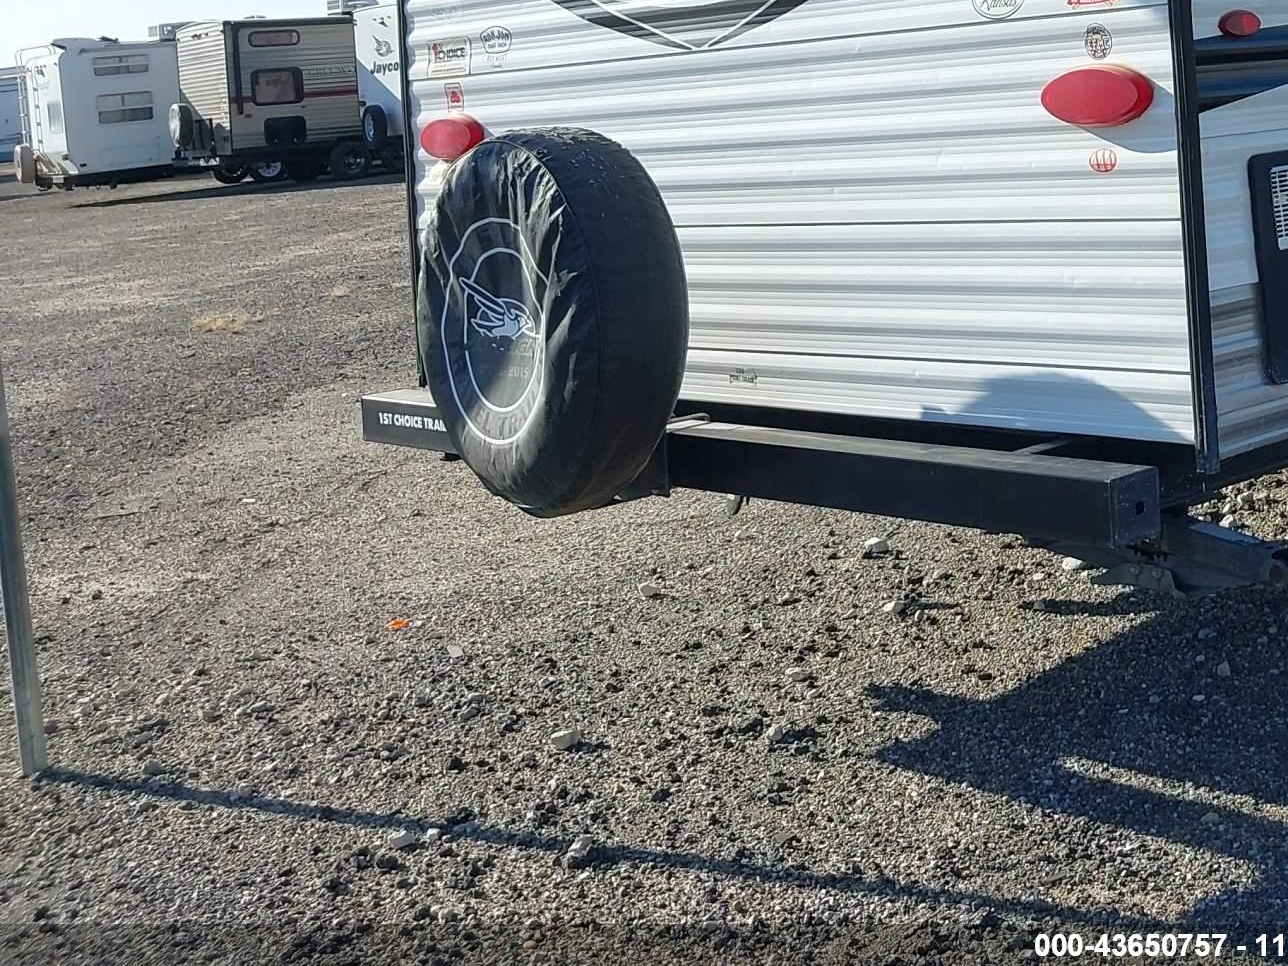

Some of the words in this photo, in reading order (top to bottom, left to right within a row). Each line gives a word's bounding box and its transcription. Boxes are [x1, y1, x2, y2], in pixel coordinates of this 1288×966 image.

[370, 61, 399, 76] Jayco
[379, 412, 393, 425] 1ST
[393, 414, 423, 428] CHOICE
